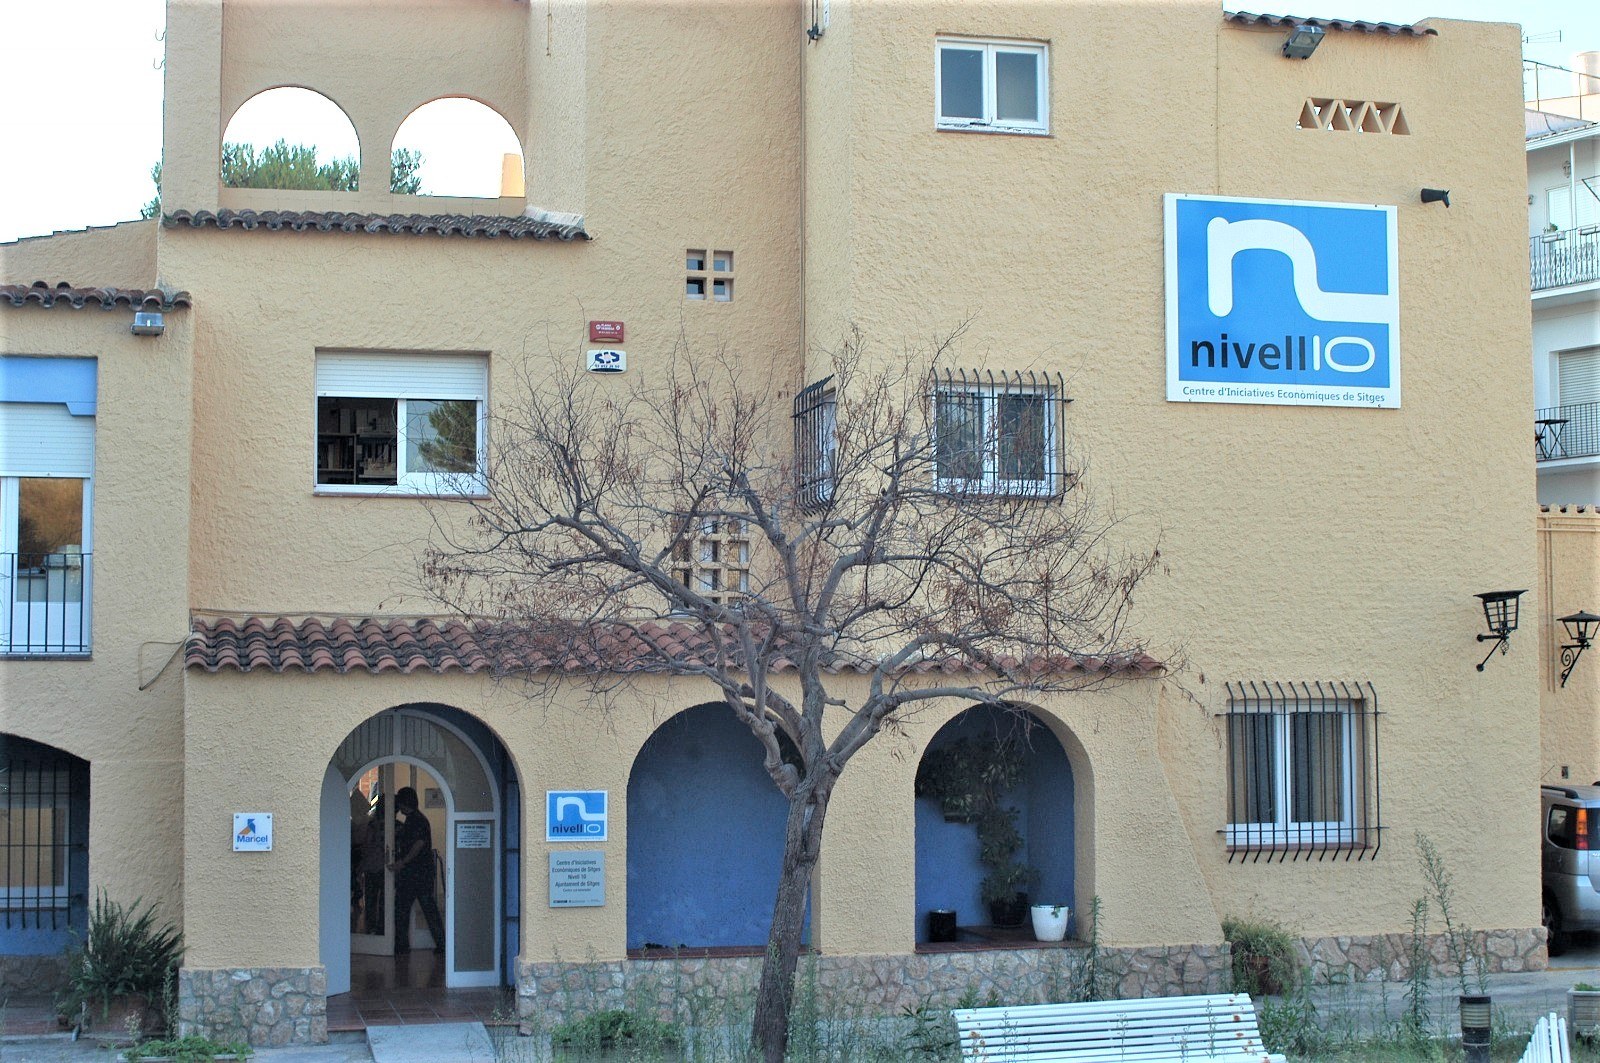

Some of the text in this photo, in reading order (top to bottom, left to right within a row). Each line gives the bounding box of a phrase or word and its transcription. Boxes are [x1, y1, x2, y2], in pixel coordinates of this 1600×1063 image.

[1182, 386, 1385, 403] Centre d'Iniciatives Econòmiques de Sitges
[236, 834, 268, 842] Maricel
